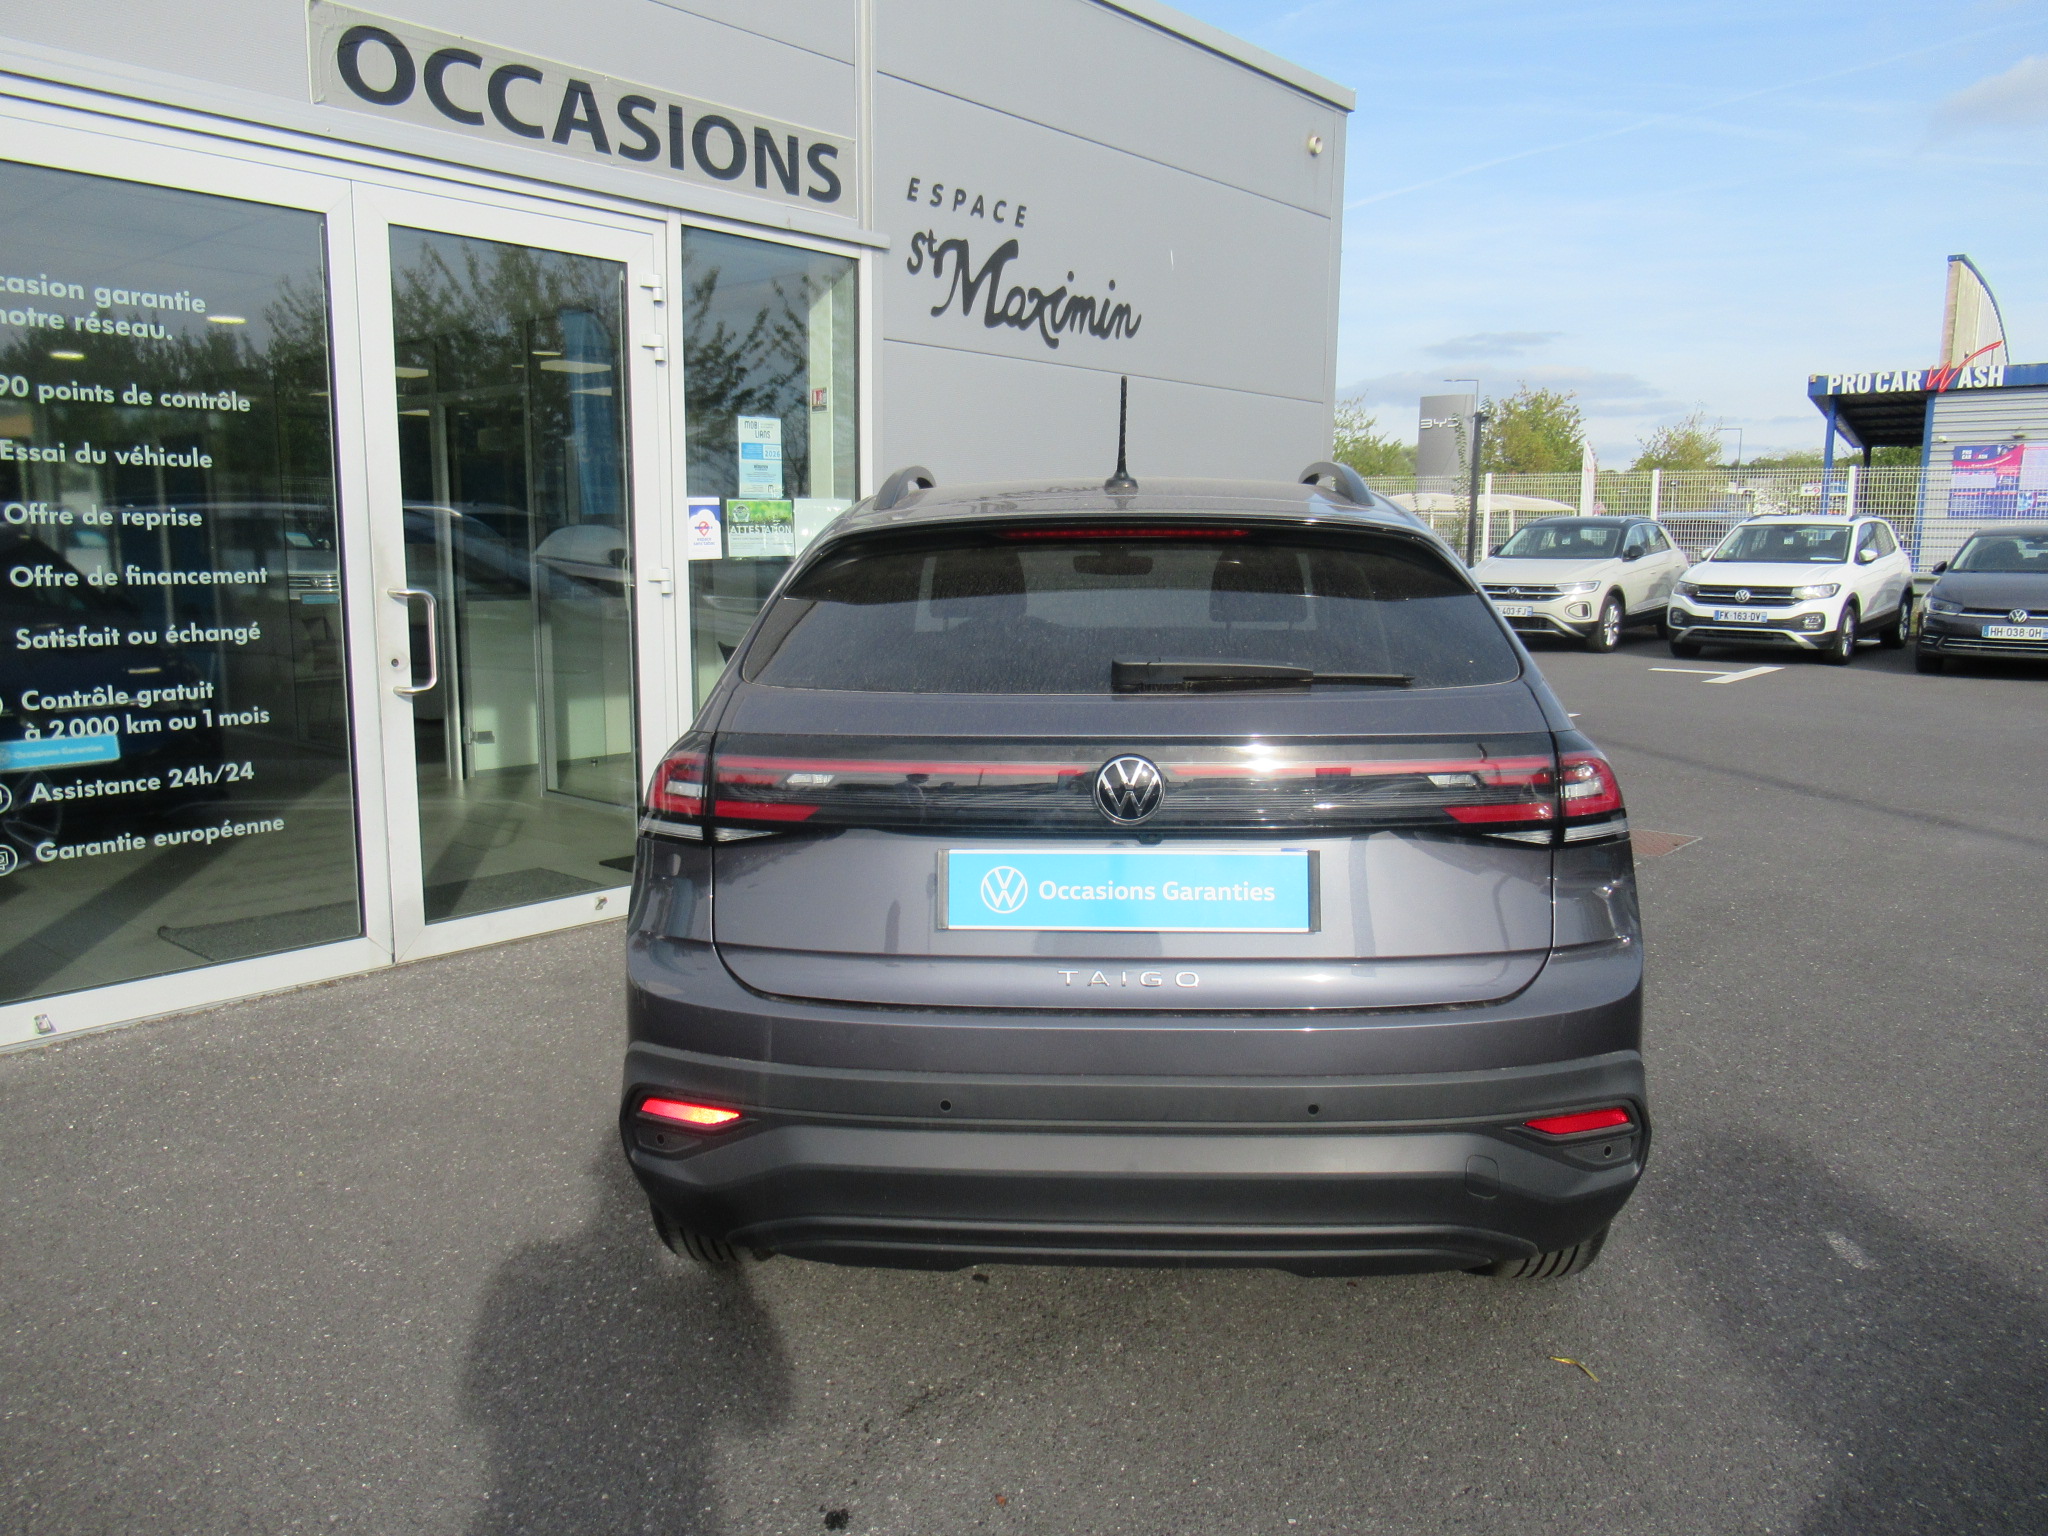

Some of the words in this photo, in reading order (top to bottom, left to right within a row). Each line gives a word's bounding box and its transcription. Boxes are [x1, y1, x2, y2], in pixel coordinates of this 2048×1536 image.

[337, 25, 842, 203] OCCASIONS
[907, 177, 1027, 228] ESPACE
[93, 282, 207, 314] garantie
[930, 238, 1142, 349] Maximin
[75, 311, 174, 340] réseau.
[1827, 374, 1872, 395] PRO
[1875, 370, 1922, 392] CAR
[1926, 346, 2005, 392] WASH
[38, 381, 115, 404] points
[122, 384, 153, 406] de
[160, 391, 251, 412] contrôle
[0, 439, 66, 462] Essai
[75, 442, 107, 464] du
[115, 445, 213, 468] véhicule
[4, 503, 74, 525] Offre
[82, 505, 113, 525] de
[121, 508, 203, 530] reprise
[730, 525, 792, 534] ATTESTATION
[10, 566, 79, 587] Offre
[87, 566, 119, 586] de
[126, 563, 268, 586] financement
[1719, 611, 1761, 621] FK-163-DV
[16, 626, 121, 649] Satisfait
[128, 631, 158, 645] ou
[166, 622, 261, 646] échangé
[21, 685, 129, 711] Contrôle
[137, 682, 215, 708] gratuit
[24, 722, 42, 741] à
[126, 713, 162, 734] km
[169, 715, 197, 731] ou
[203, 709, 213, 728] 1
[219, 706, 270, 727] mois
[30, 777, 161, 803] Assistance
[168, 762, 254, 788] 24h/24
[35, 831, 147, 862] Garantie
[154, 817, 285, 847] européenne
[1038, 879, 1156, 902] Occasions
[1161, 880, 1276, 902] Garanties
[1057, 969, 1201, 988] TAIGO
